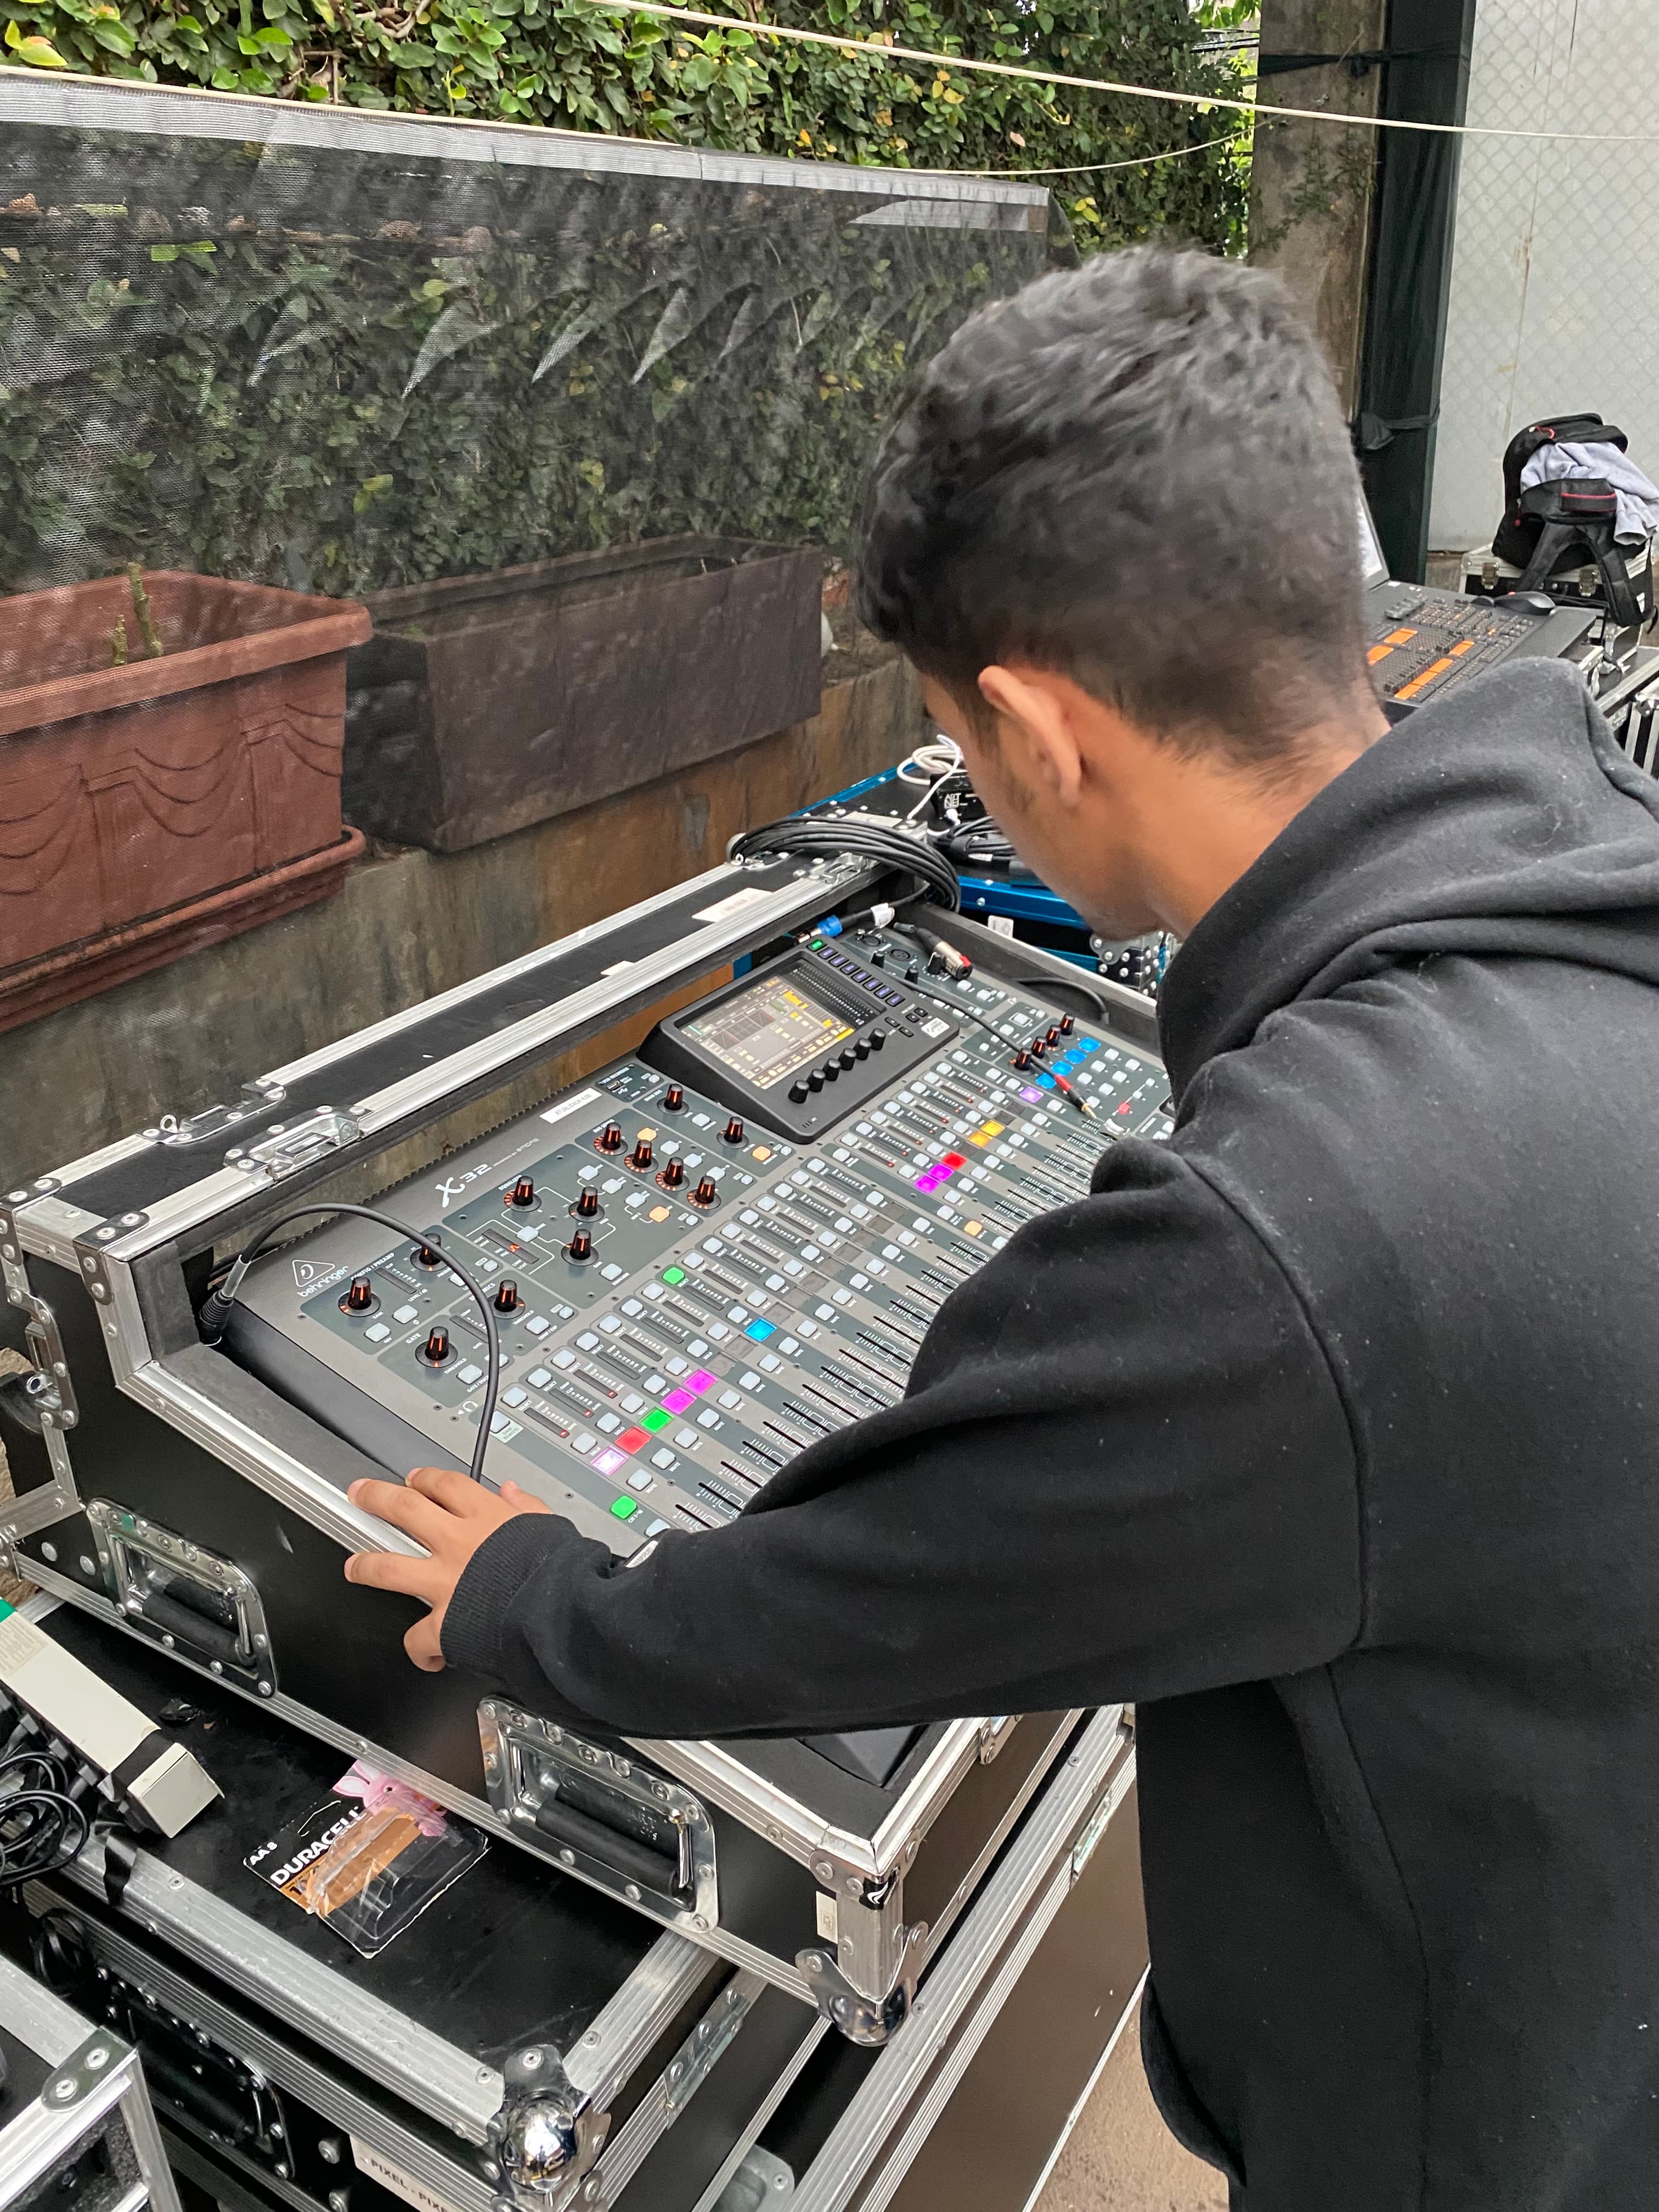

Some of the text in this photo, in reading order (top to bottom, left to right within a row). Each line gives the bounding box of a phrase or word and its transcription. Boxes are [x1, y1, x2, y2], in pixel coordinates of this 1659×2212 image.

[435, 1164, 492, 1207] X32
[297, 1265, 349, 1297] behringer
[406, 1333, 422, 1344] GATE
[543, 1381, 558, 1391] SELECT
[614, 1426, 625, 1436] SOLO
[250, 1842, 278, 1866] AA 8
[371, 2158, 409, 2191] PIXEL
